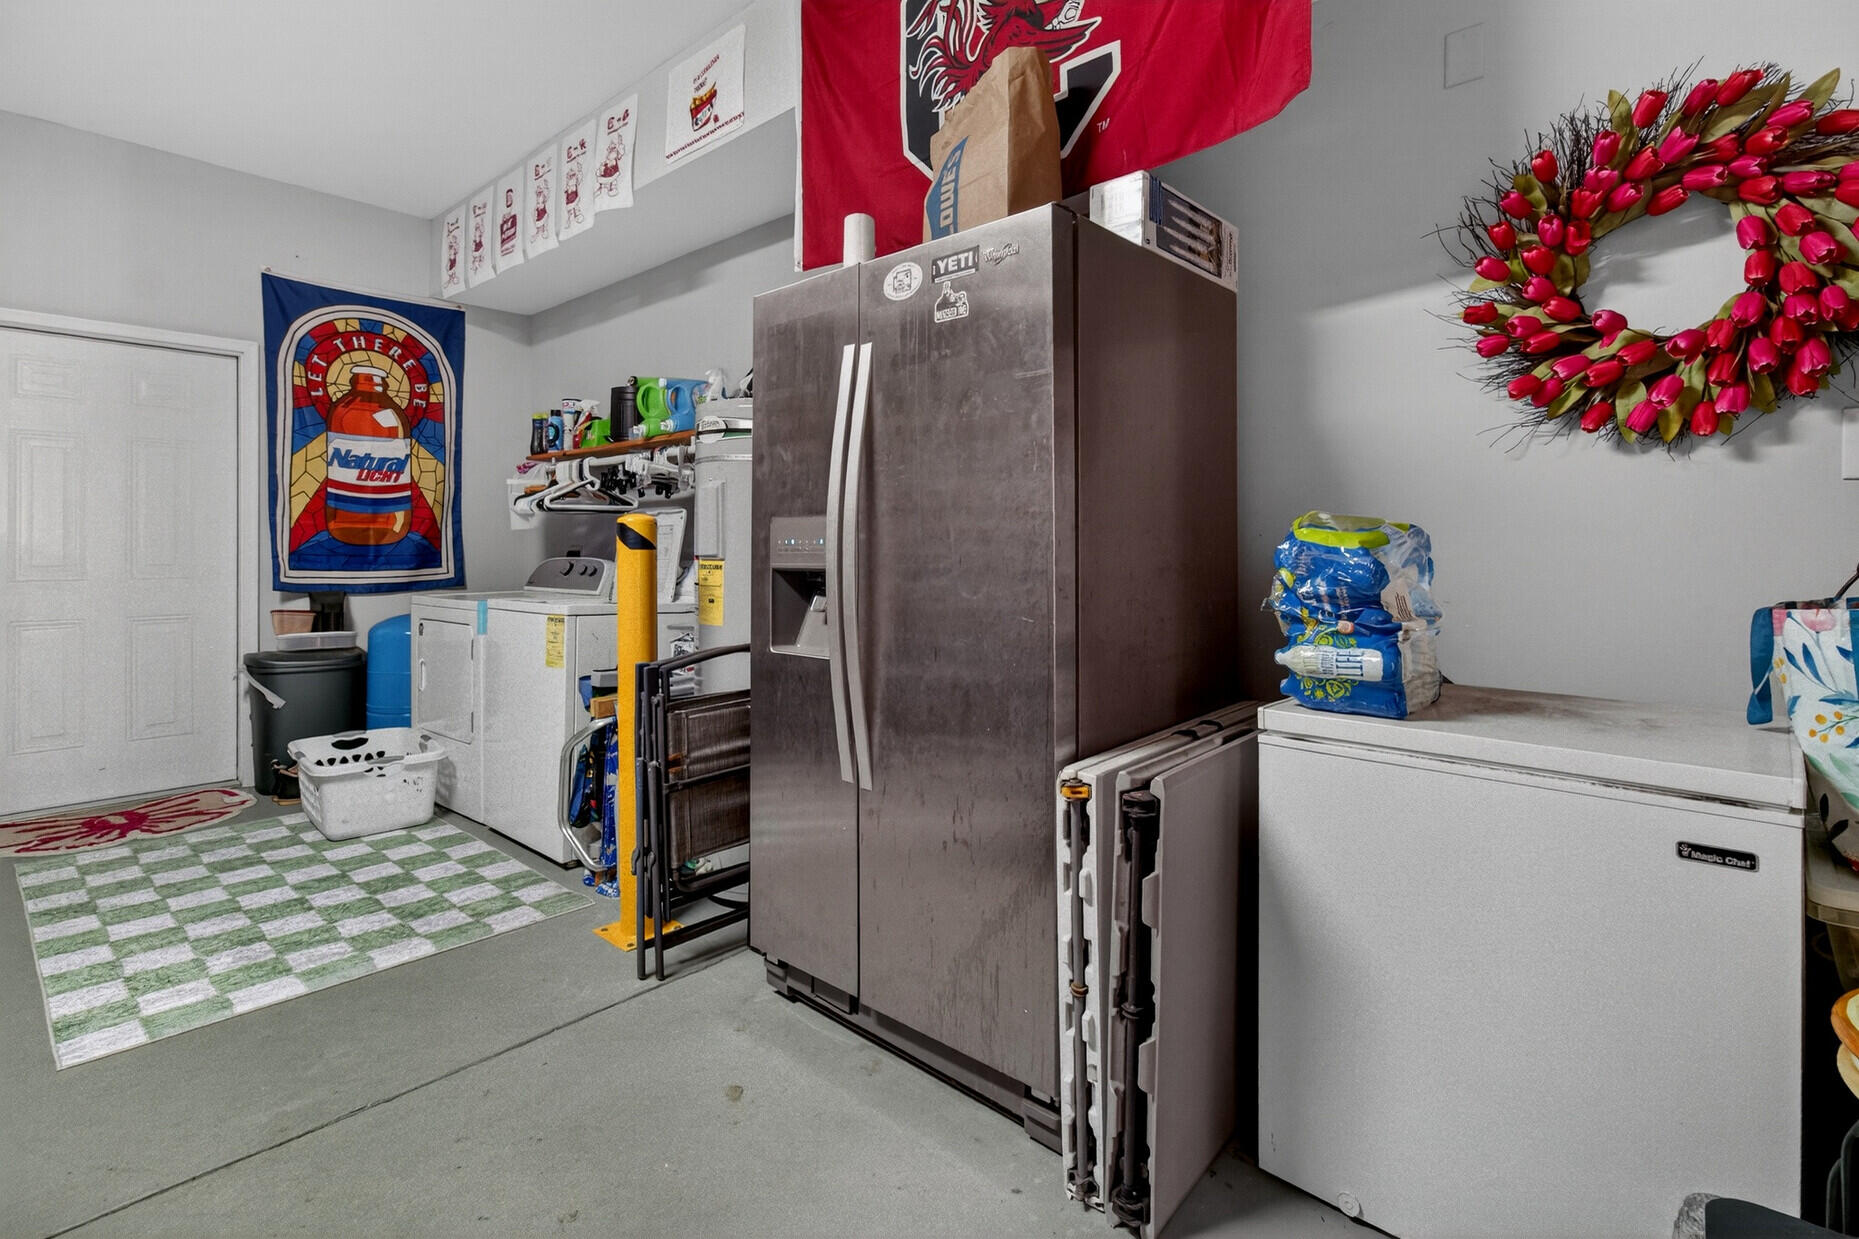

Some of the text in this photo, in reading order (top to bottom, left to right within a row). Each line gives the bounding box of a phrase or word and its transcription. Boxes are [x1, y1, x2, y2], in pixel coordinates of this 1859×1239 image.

[1096, 117, 1110, 133] TM
[936, 250, 974, 275] YETI
[308, 336, 427, 408] LET THERE BE
[328, 446, 411, 474] Natural
[1691, 850, 1751, 868] Magic Chef
